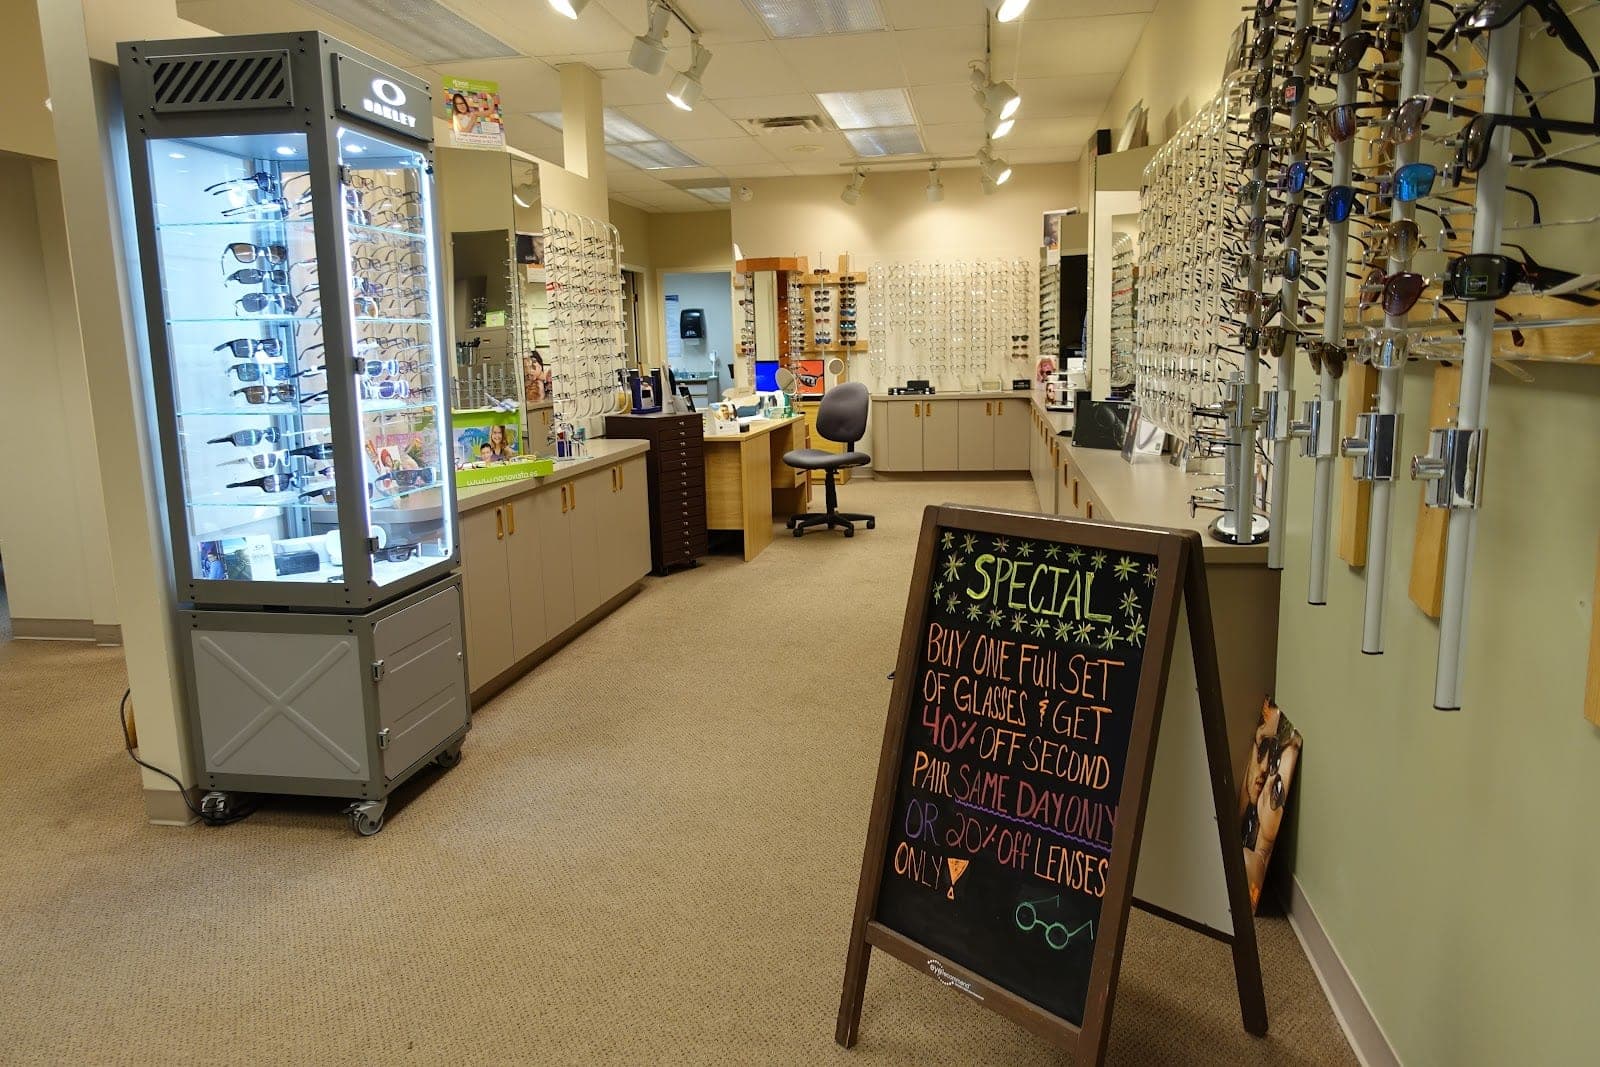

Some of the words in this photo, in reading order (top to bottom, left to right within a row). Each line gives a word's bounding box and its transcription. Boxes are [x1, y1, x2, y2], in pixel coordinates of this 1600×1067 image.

[966, 553, 1112, 623] SPECIAL
[927, 622, 971, 669] BUY
[972, 634, 1016, 681] ONE
[1060, 654, 1125, 701] SET
[922, 704, 978, 753] 40%
[979, 726, 1026, 765] OFF
[1022, 736, 1111, 790] SECOND
[923, 670, 950, 704] OF
[953, 676, 1028, 726] GLASSES
[1053, 700, 1113, 744] GET
[912, 751, 953, 797] PAIR
[954, 764, 1010, 813] SAME
[1016, 781, 1064, 827] DAY
[1065, 795, 1118, 844] ONLY
[905, 799, 940, 846] OR
[946, 812, 998, 853] 20%
[1034, 837, 1109, 898] LENSES
